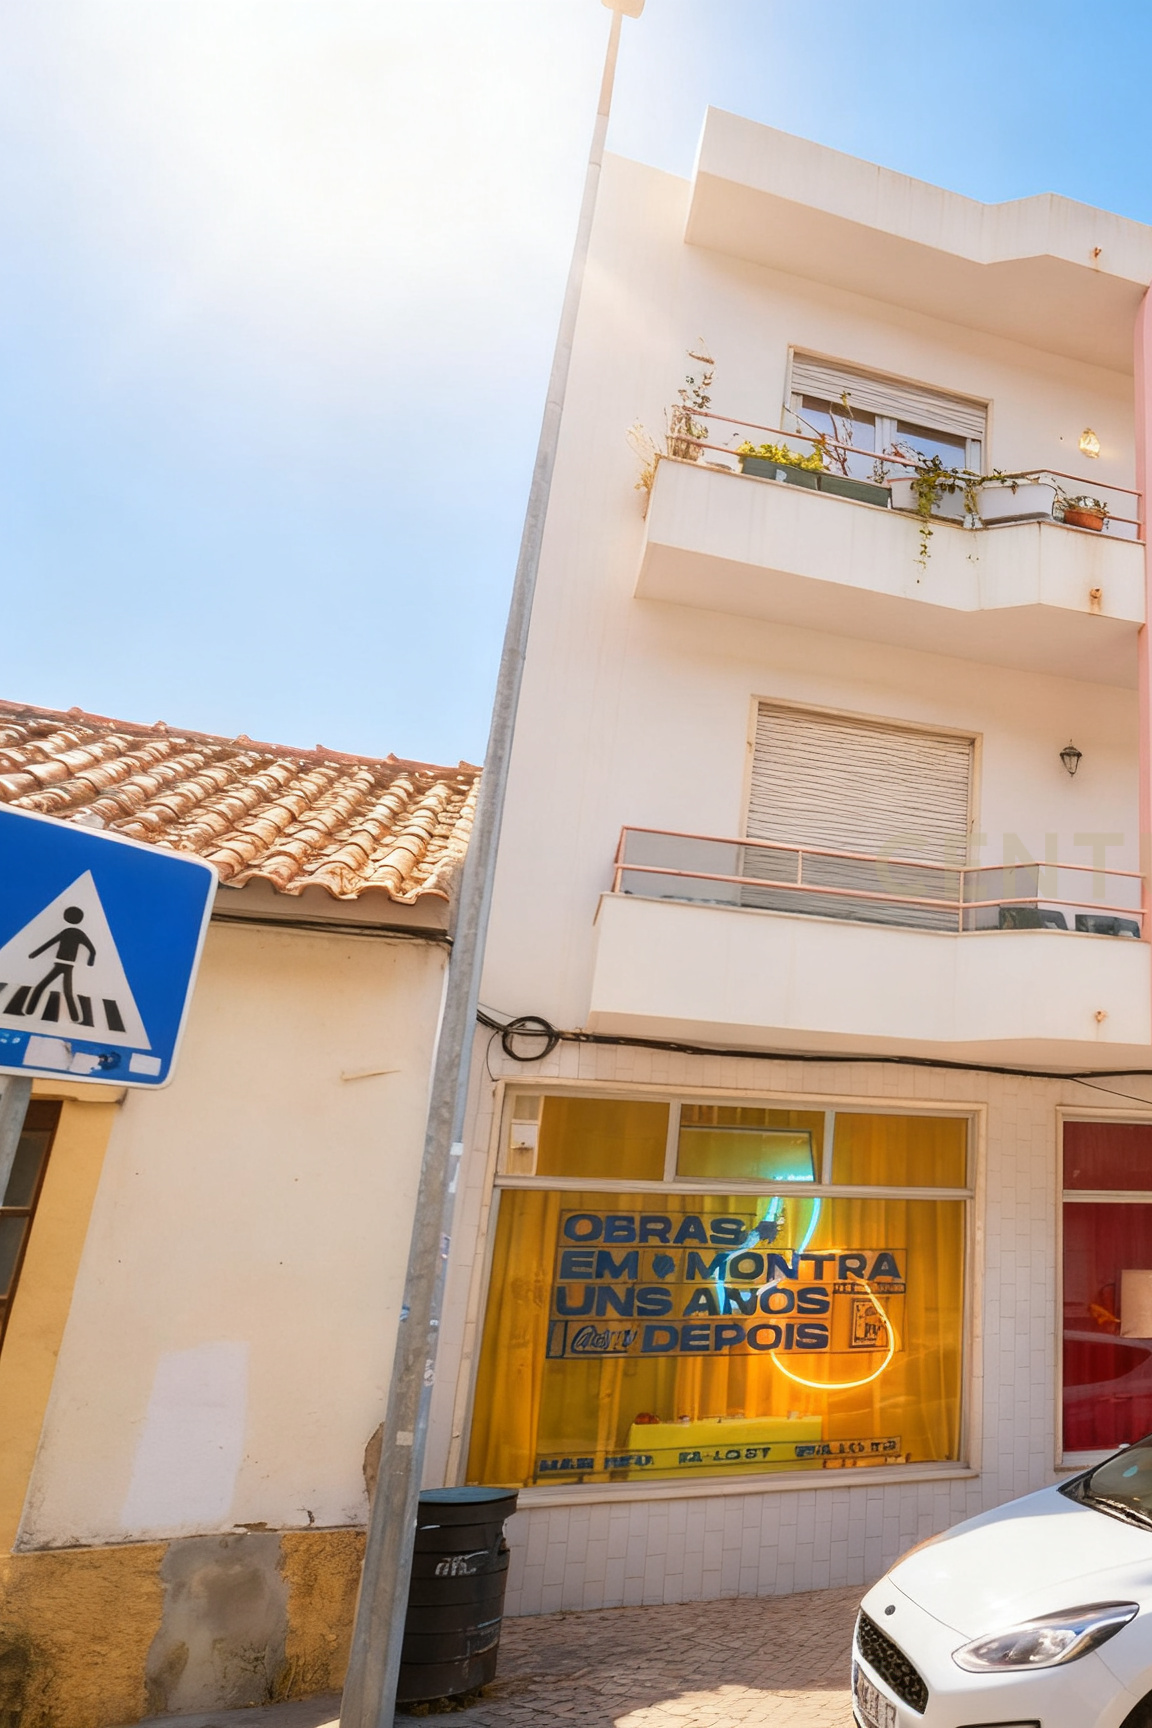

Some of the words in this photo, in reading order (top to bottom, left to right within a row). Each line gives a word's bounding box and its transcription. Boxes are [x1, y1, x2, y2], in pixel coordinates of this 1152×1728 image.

[564, 1214, 745, 1246] OBRAS
[560, 1250, 639, 1279] EM
[685, 1251, 902, 1281] MONTRA
[556, 1285, 674, 1317] UNS
[682, 1286, 830, 1317] ANOS
[640, 1322, 829, 1353] DEPOIS
